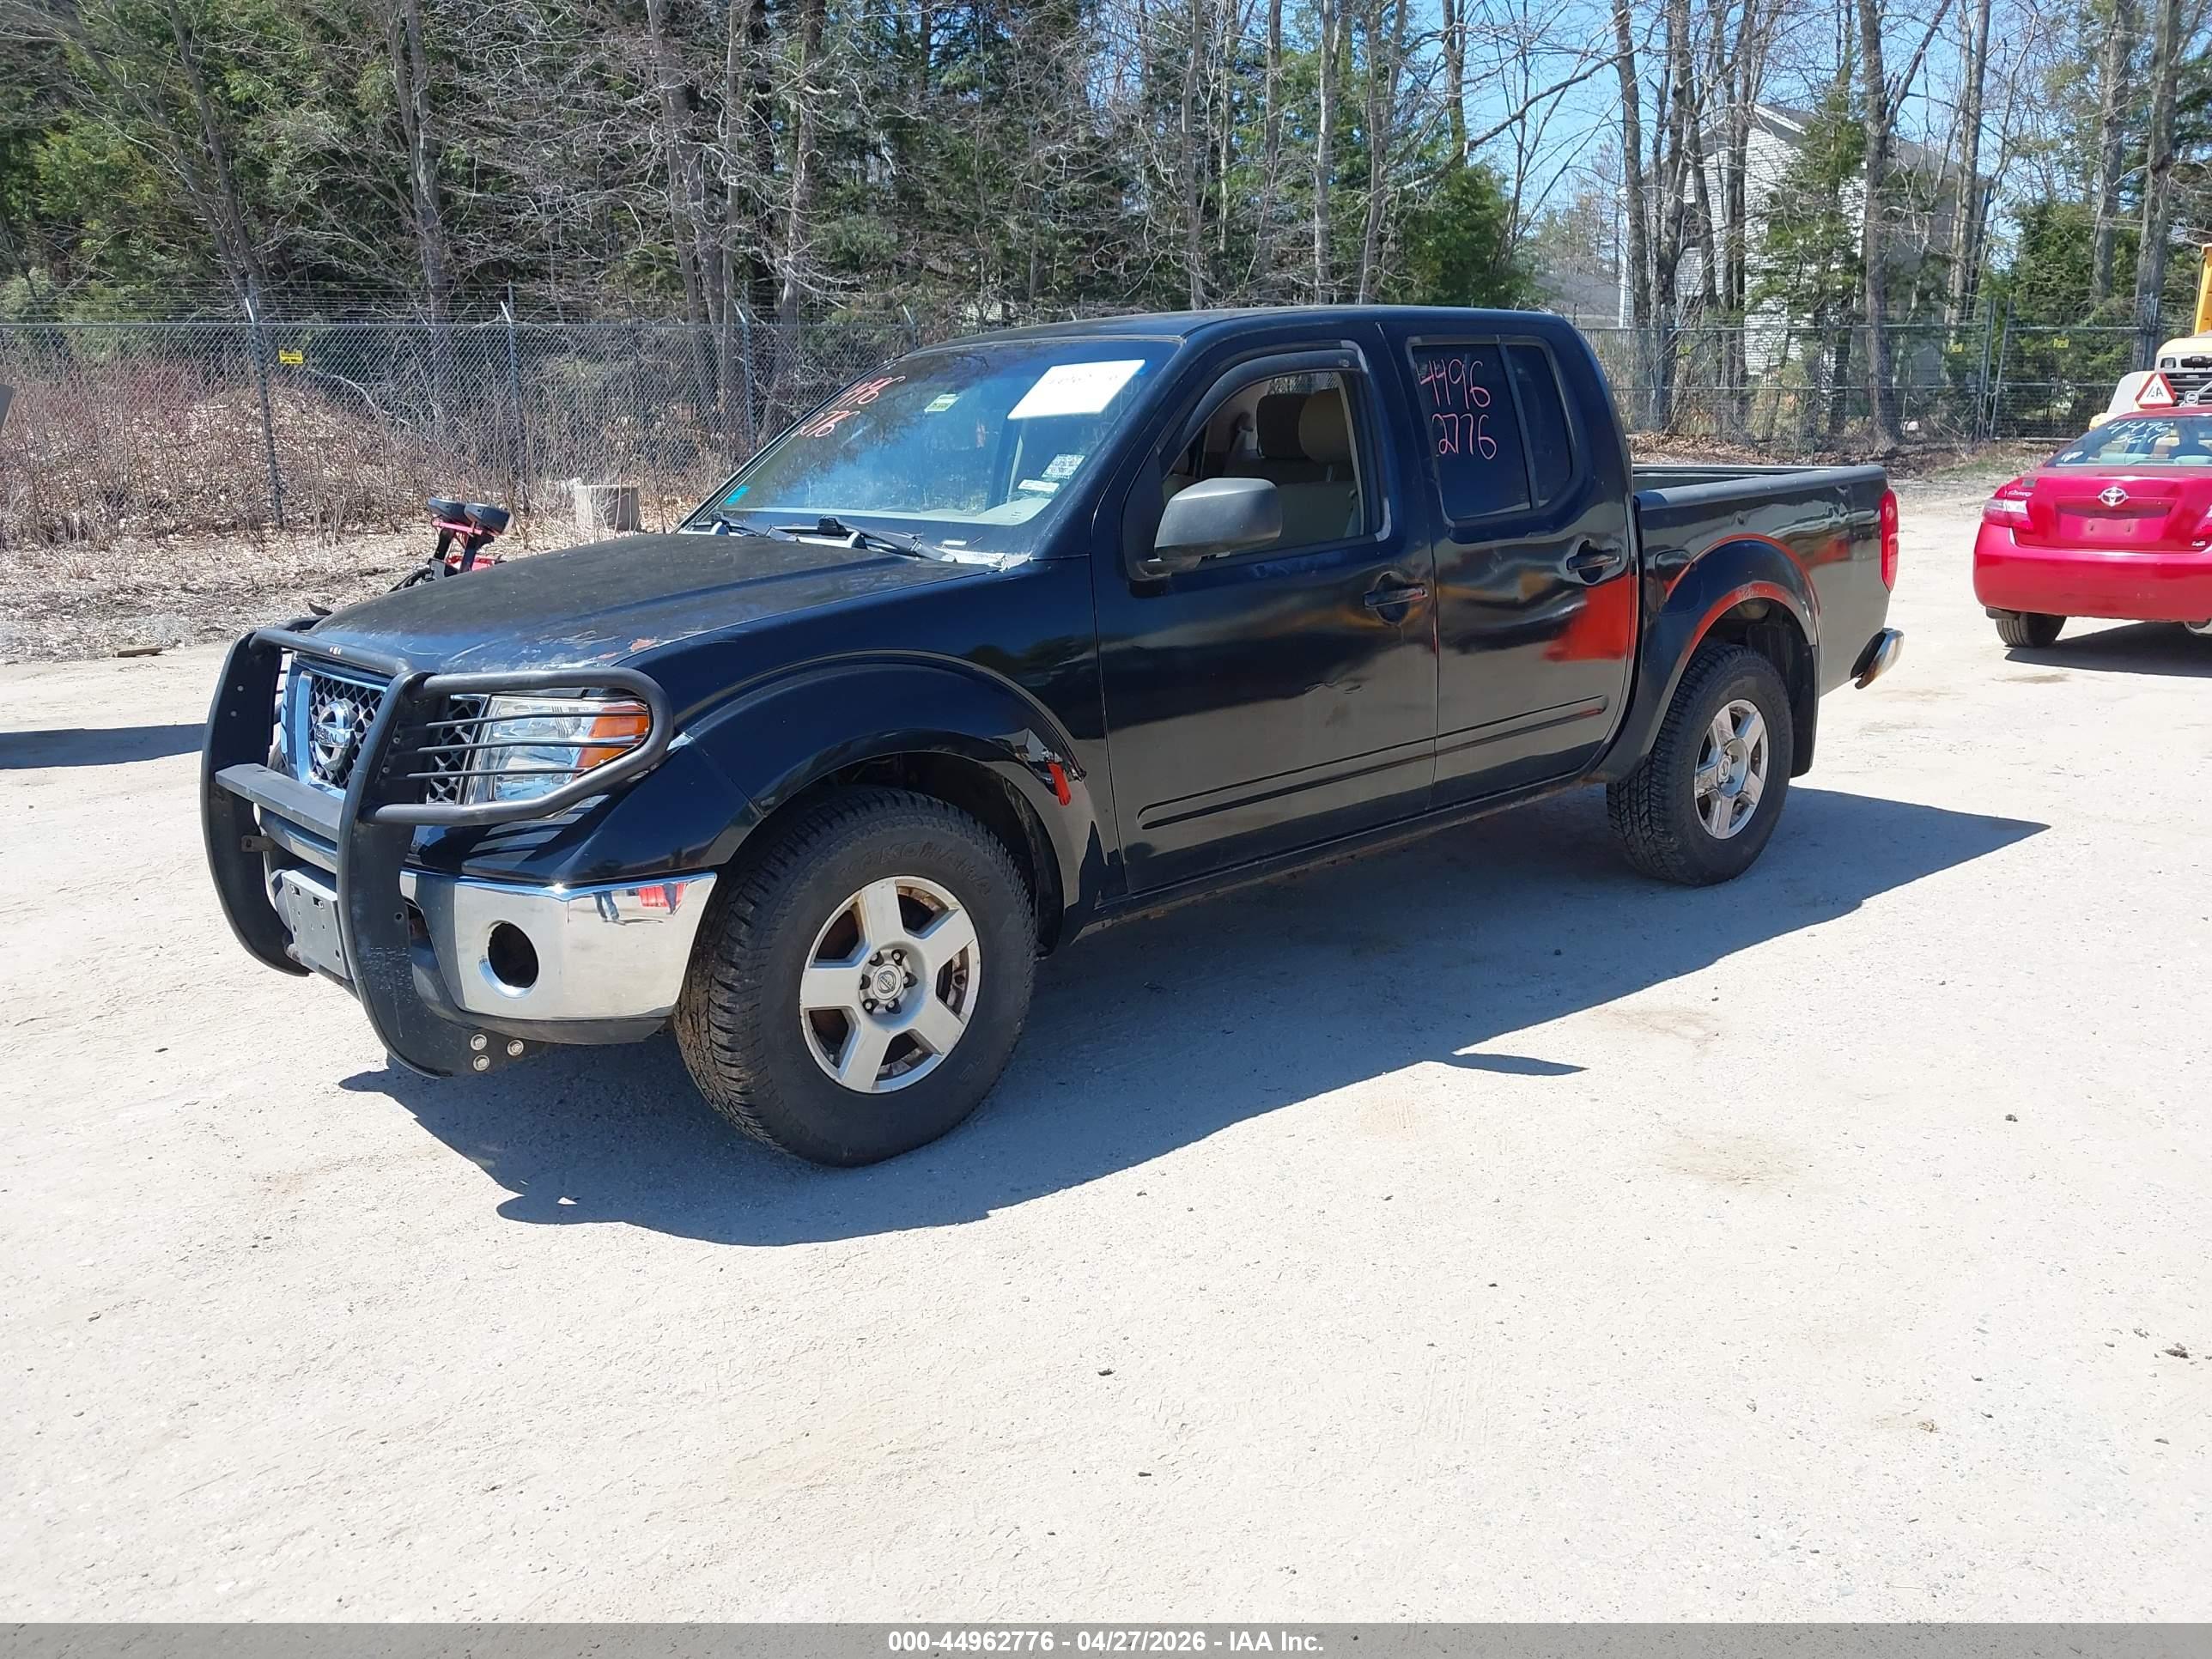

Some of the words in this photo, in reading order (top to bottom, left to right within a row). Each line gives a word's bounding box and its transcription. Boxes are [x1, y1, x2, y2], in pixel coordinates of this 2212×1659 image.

[1415, 358, 1491, 410] 4496
[1431, 413, 1497, 460] 2776
[2106, 421, 2174, 434] 4496
